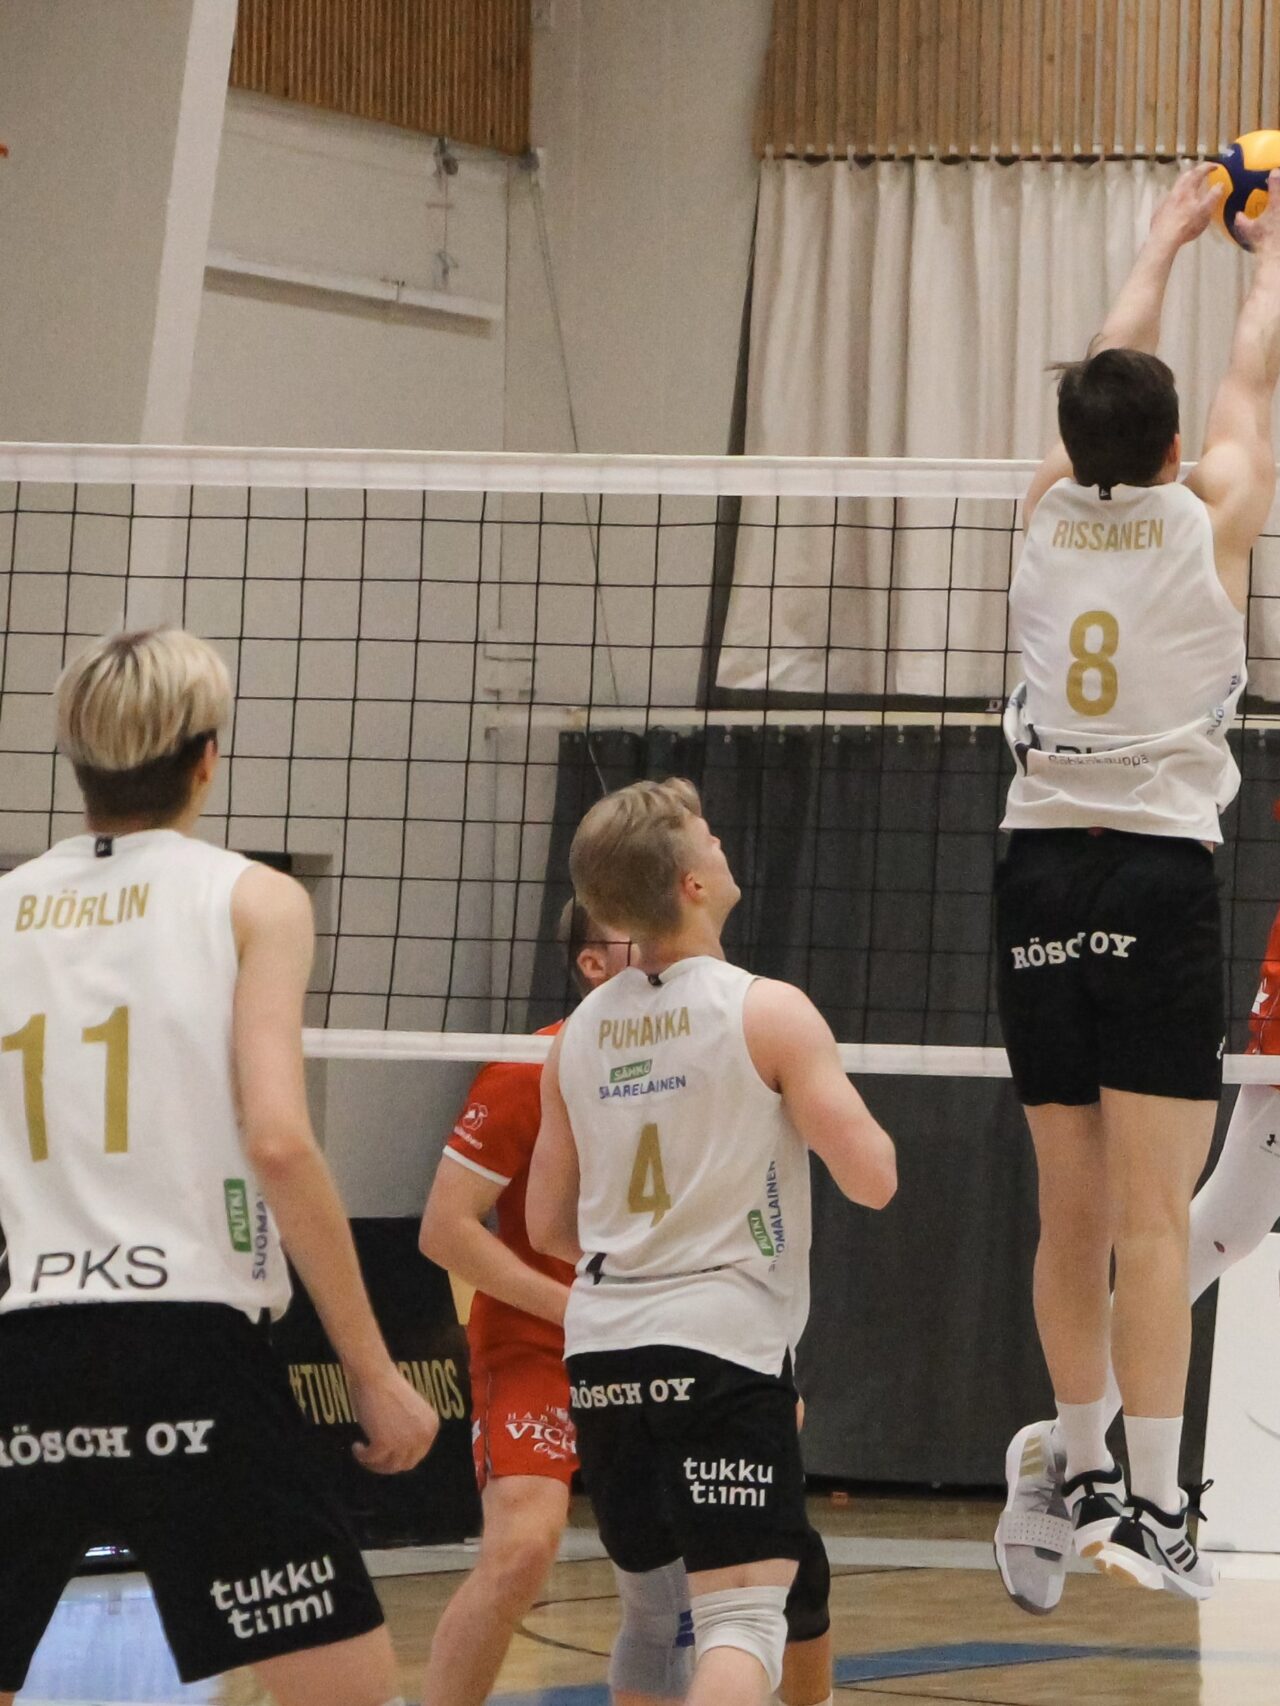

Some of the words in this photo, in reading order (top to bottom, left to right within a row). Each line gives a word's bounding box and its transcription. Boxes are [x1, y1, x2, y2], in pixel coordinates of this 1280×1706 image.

[1052, 518, 1164, 552] RISSANEN
[1066, 610, 1120, 716] 8
[15, 883, 149, 932] BJÖRLIN
[1090, 931, 1137, 957] OY
[598, 1006, 691, 1050] PUHAKKA
[0, 1005, 129, 1163] 11
[599, 1075, 687, 1100] SAARELAINEN
[627, 1122, 672, 1228] 4
[30, 1245, 168, 1293] PKS
[570, 1380, 643, 1408] RÖSCH
[650, 1378, 696, 1402] OY
[146, 1420, 214, 1456] OY
[683, 1457, 774, 1484] tukku
[210, 1555, 335, 1610] tukku
